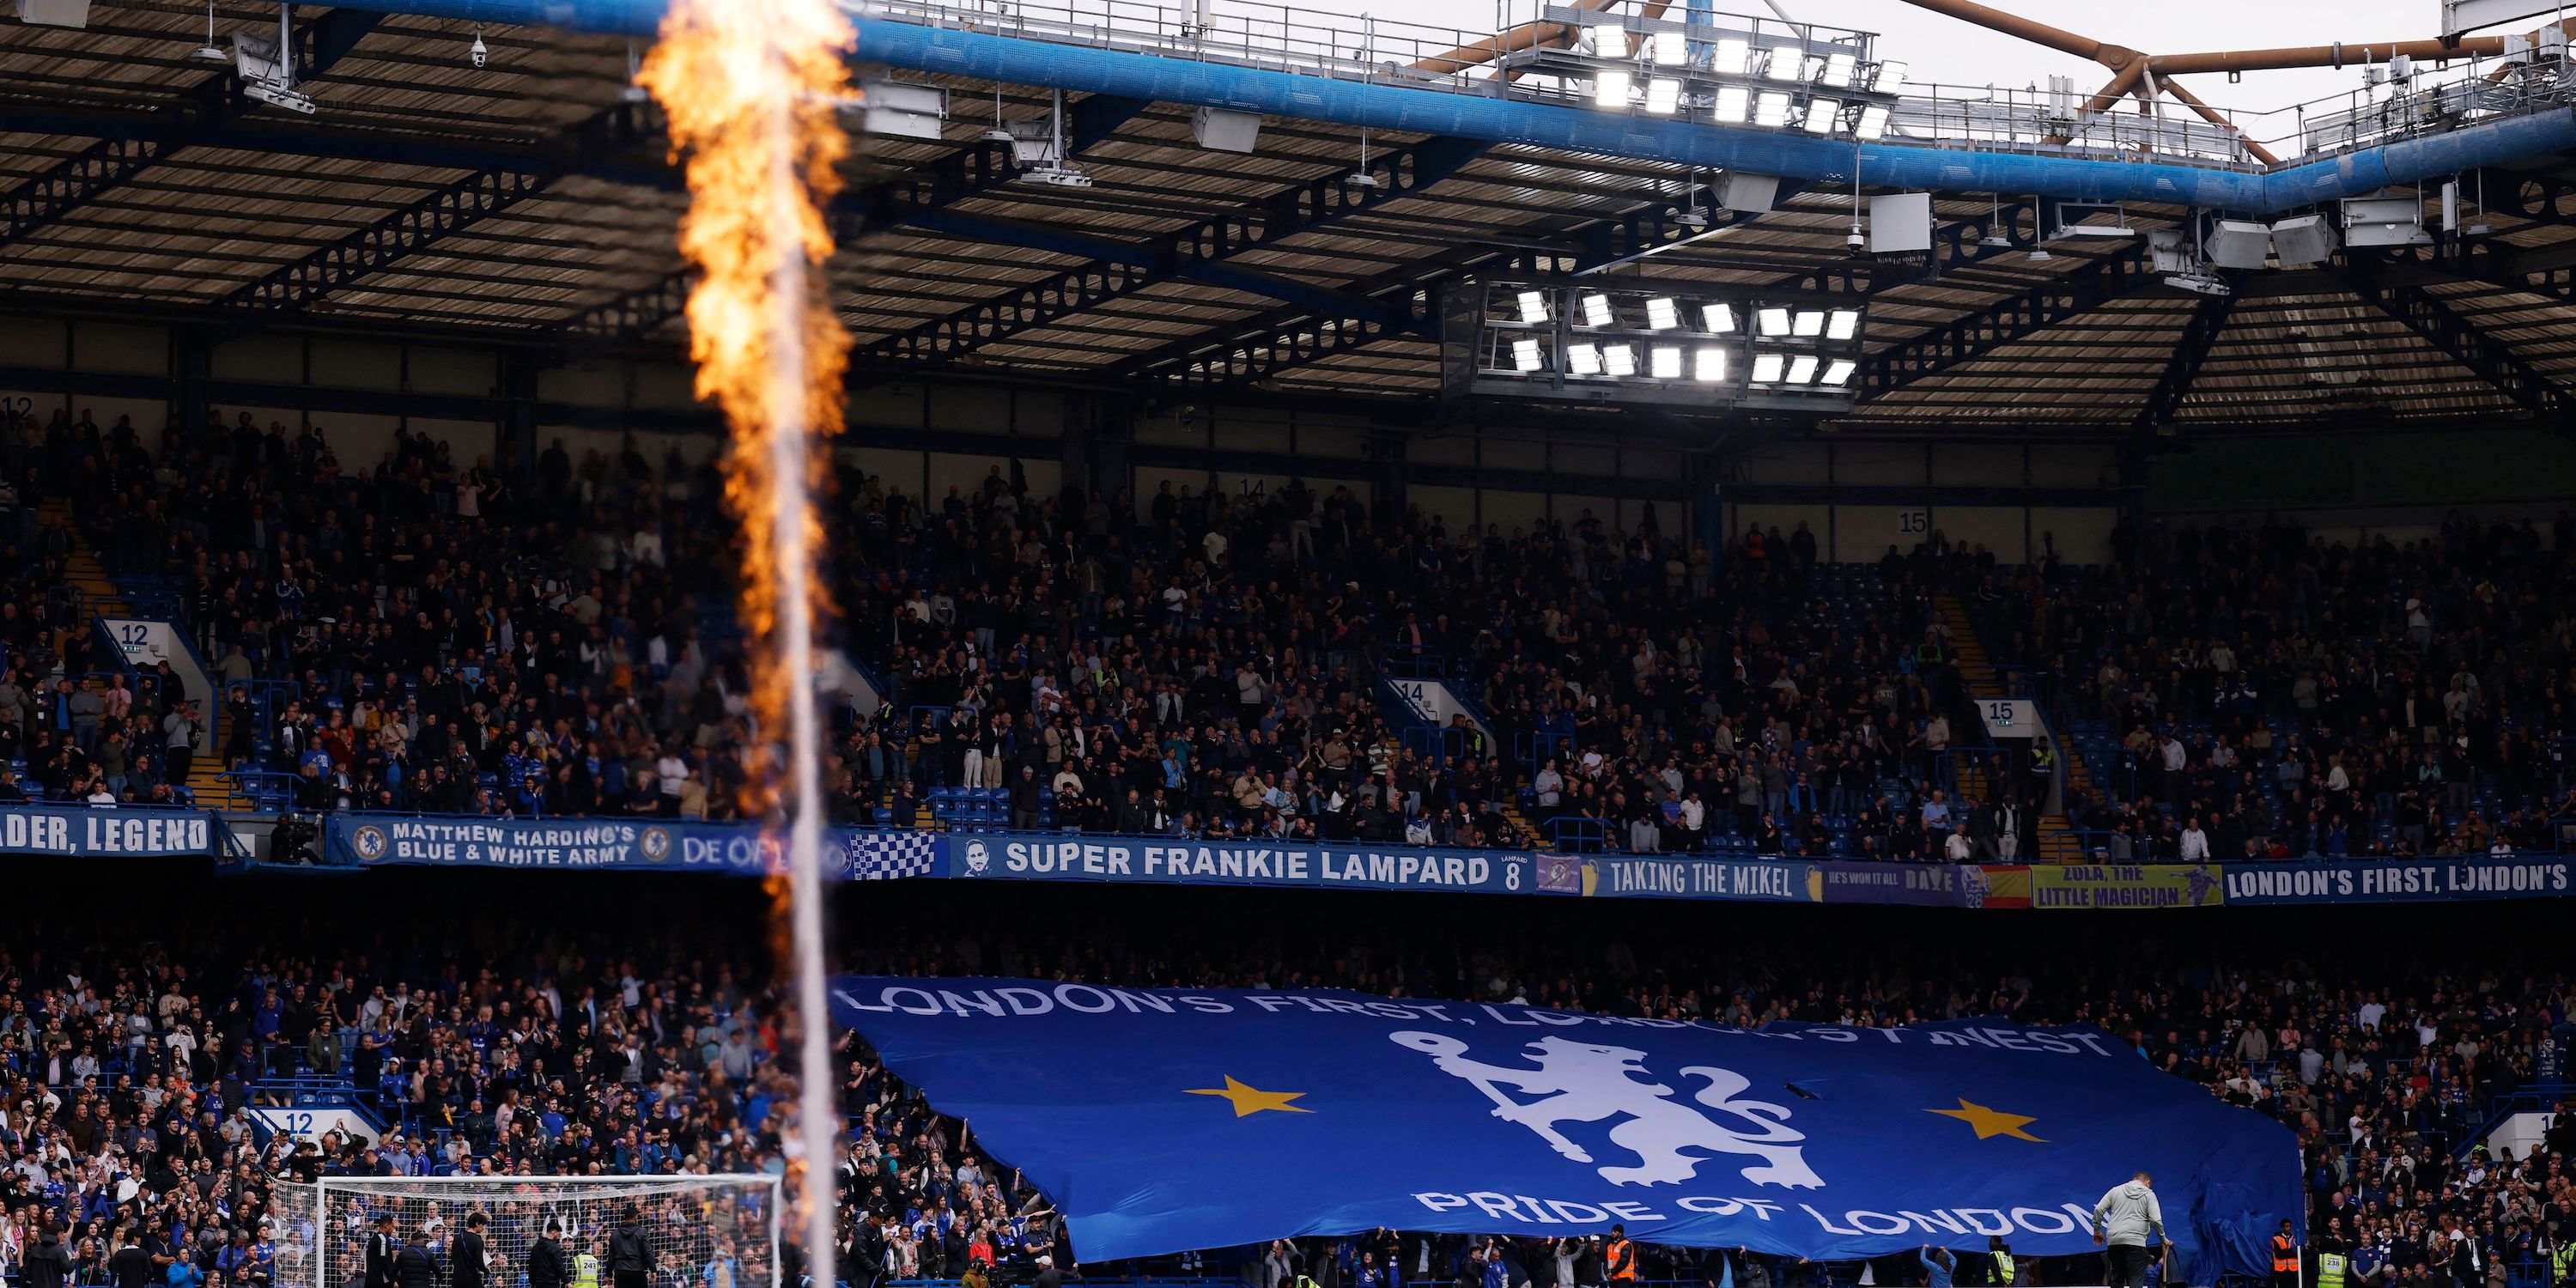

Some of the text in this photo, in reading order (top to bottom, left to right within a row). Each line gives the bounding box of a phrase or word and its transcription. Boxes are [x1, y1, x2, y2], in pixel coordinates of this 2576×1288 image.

[2, 397, 33, 421] 12
[1241, 478, 1265, 500] 14
[1900, 513, 1926, 532] 15
[122, 624, 148, 646] 12
[1402, 683, 1423, 702] 14
[1990, 702, 2014, 720] 15
[0, 814, 209, 855] DER, LEGEND
[393, 823, 636, 848] MATTHEW HARDING'S
[398, 841, 632, 865] BLUE & WHITE ARMY
[1006, 841, 1490, 886] SUPER FRANKIE LAMPARD
[1501, 854, 1528, 865] LAMPARD
[1505, 862, 1521, 891] 8
[1611, 861, 1793, 897] TAKING THE MIKEL
[1828, 872, 1899, 885] HE'S WON IT ALL
[2063, 866, 2144, 883] ZOLA, THE
[2227, 864, 2567, 899] LONDON'S FIRST, LONDON'S
[1967, 893, 1984, 908] 28
[2038, 887, 2179, 907] LITTLE MAGICIAN
[834, 983, 1236, 1018] LONDON'S
[1243, 995, 1476, 1026] FIRST,
[286, 1113, 313, 1134] 12
[1410, 1191, 2111, 1237] PRIDE OF LONDON
